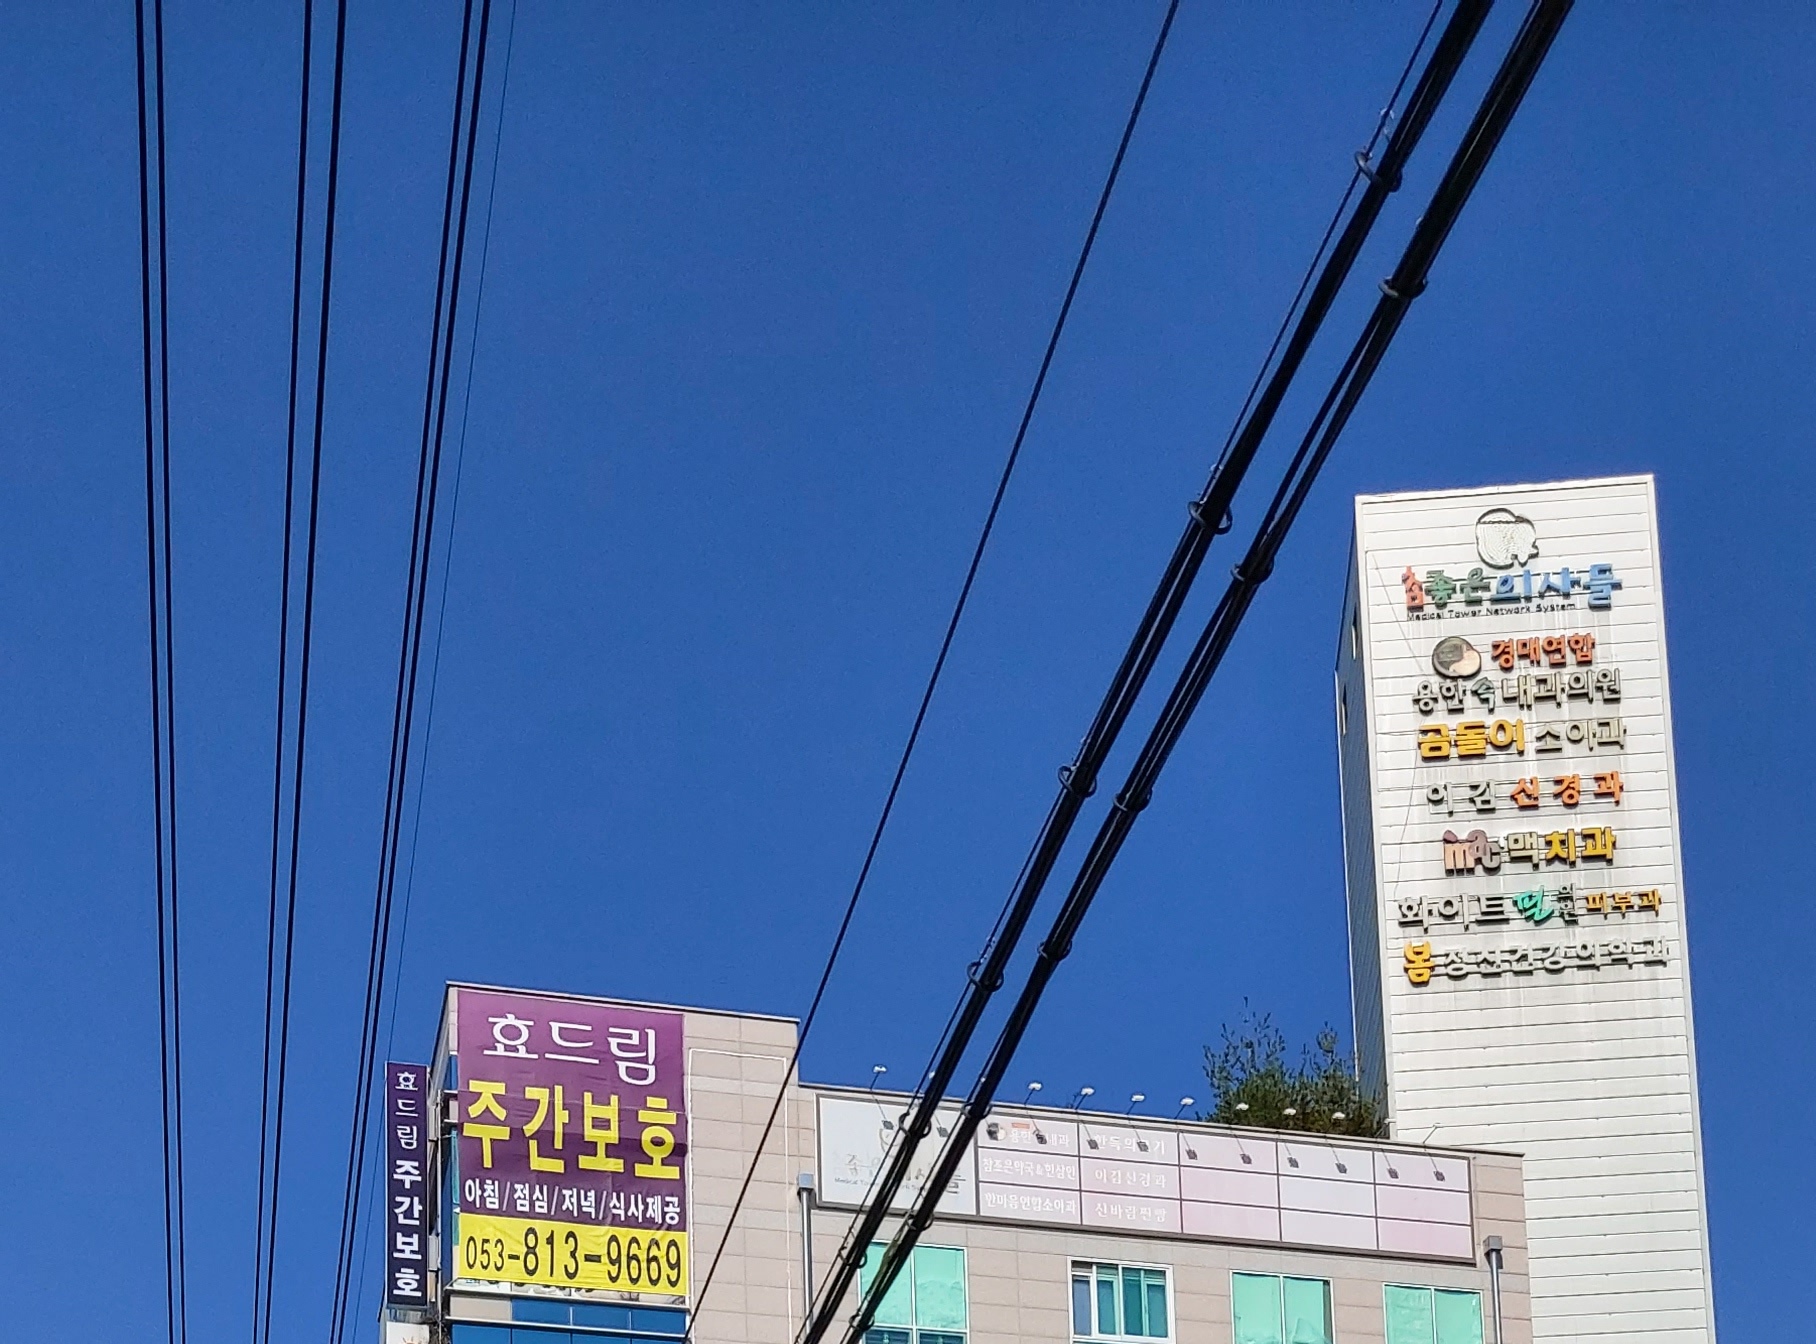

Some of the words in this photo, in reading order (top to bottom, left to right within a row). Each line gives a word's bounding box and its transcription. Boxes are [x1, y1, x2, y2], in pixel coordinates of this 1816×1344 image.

[1448, 608, 1482, 619] Tower
[1486, 605, 1531, 616] Network
[1535, 602, 1577, 614] System
[1492, 632, 1596, 670] 경대연합
[1412, 667, 1622, 715] 용한속내과의원
[1417, 718, 1526, 759] 곰돌이
[1535, 718, 1627, 752] 소아과
[1506, 826, 1617, 871] 맥치과
[1585, 888, 1662, 919] 피부과
[481, 1012, 657, 1087] 효드림
[394, 1071, 419, 1150] 효드림
[462, 1079, 682, 1180] 주간보호
[1009, 1128, 1070, 1148] 용한내과
[392, 1160, 422, 1298] 주간보호
[466, 1226, 681, 1288] 053-813-9669
